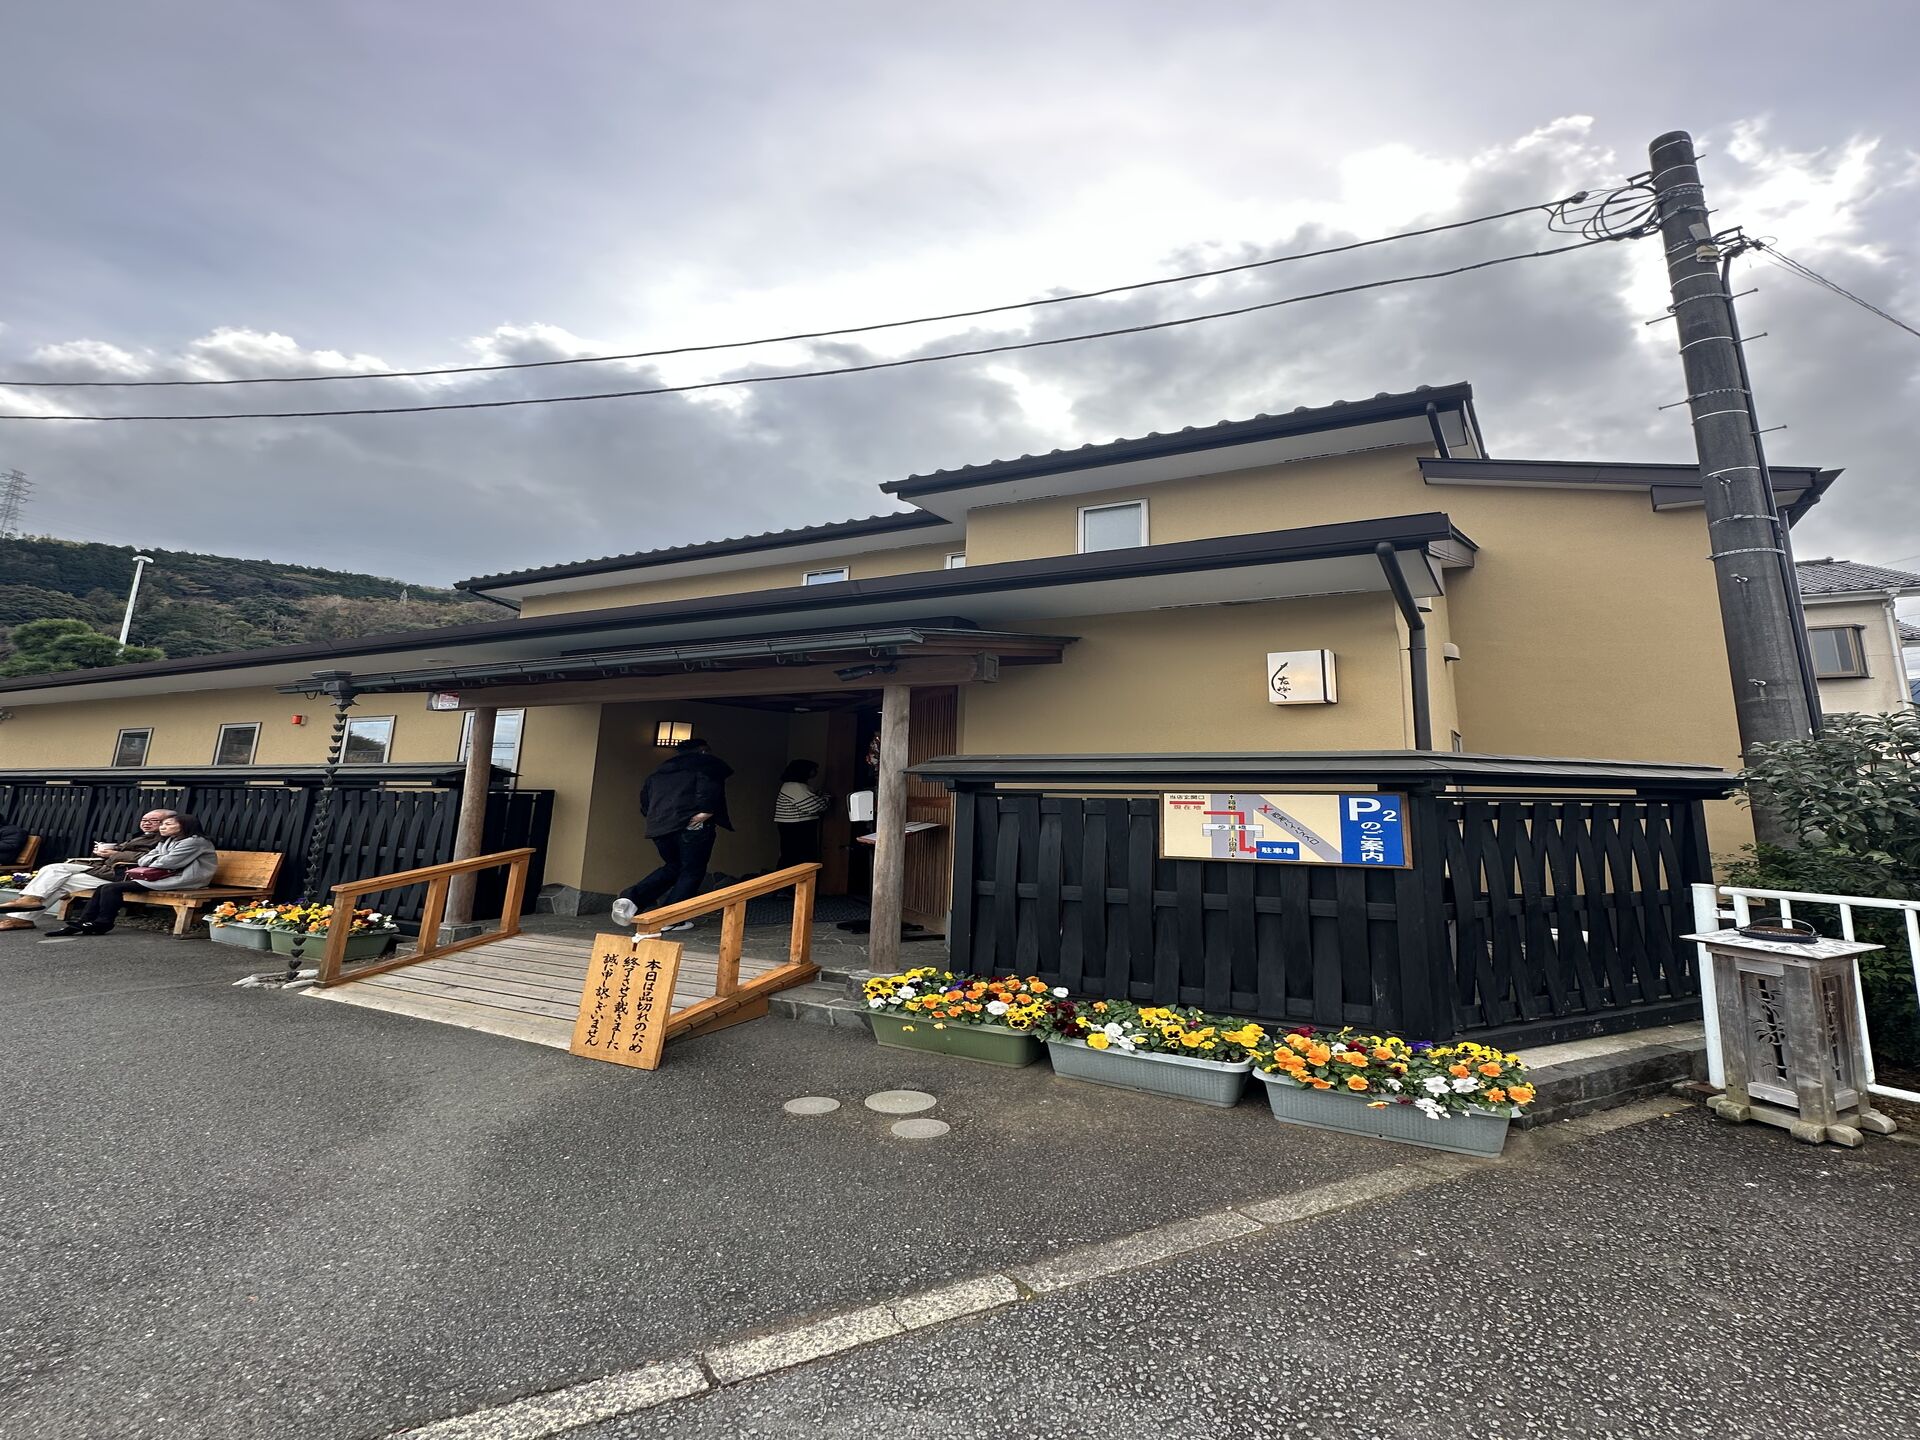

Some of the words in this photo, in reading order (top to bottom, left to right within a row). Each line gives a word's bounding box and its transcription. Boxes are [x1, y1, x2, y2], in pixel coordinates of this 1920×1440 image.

[1261, 846, 1294, 855] 駐車場
[1360, 821, 1385, 863] のご案内
[584, 953, 619, 1047] 誠に申し訳ございません
[628, 959, 663, 1053] 本日は品切れのため
